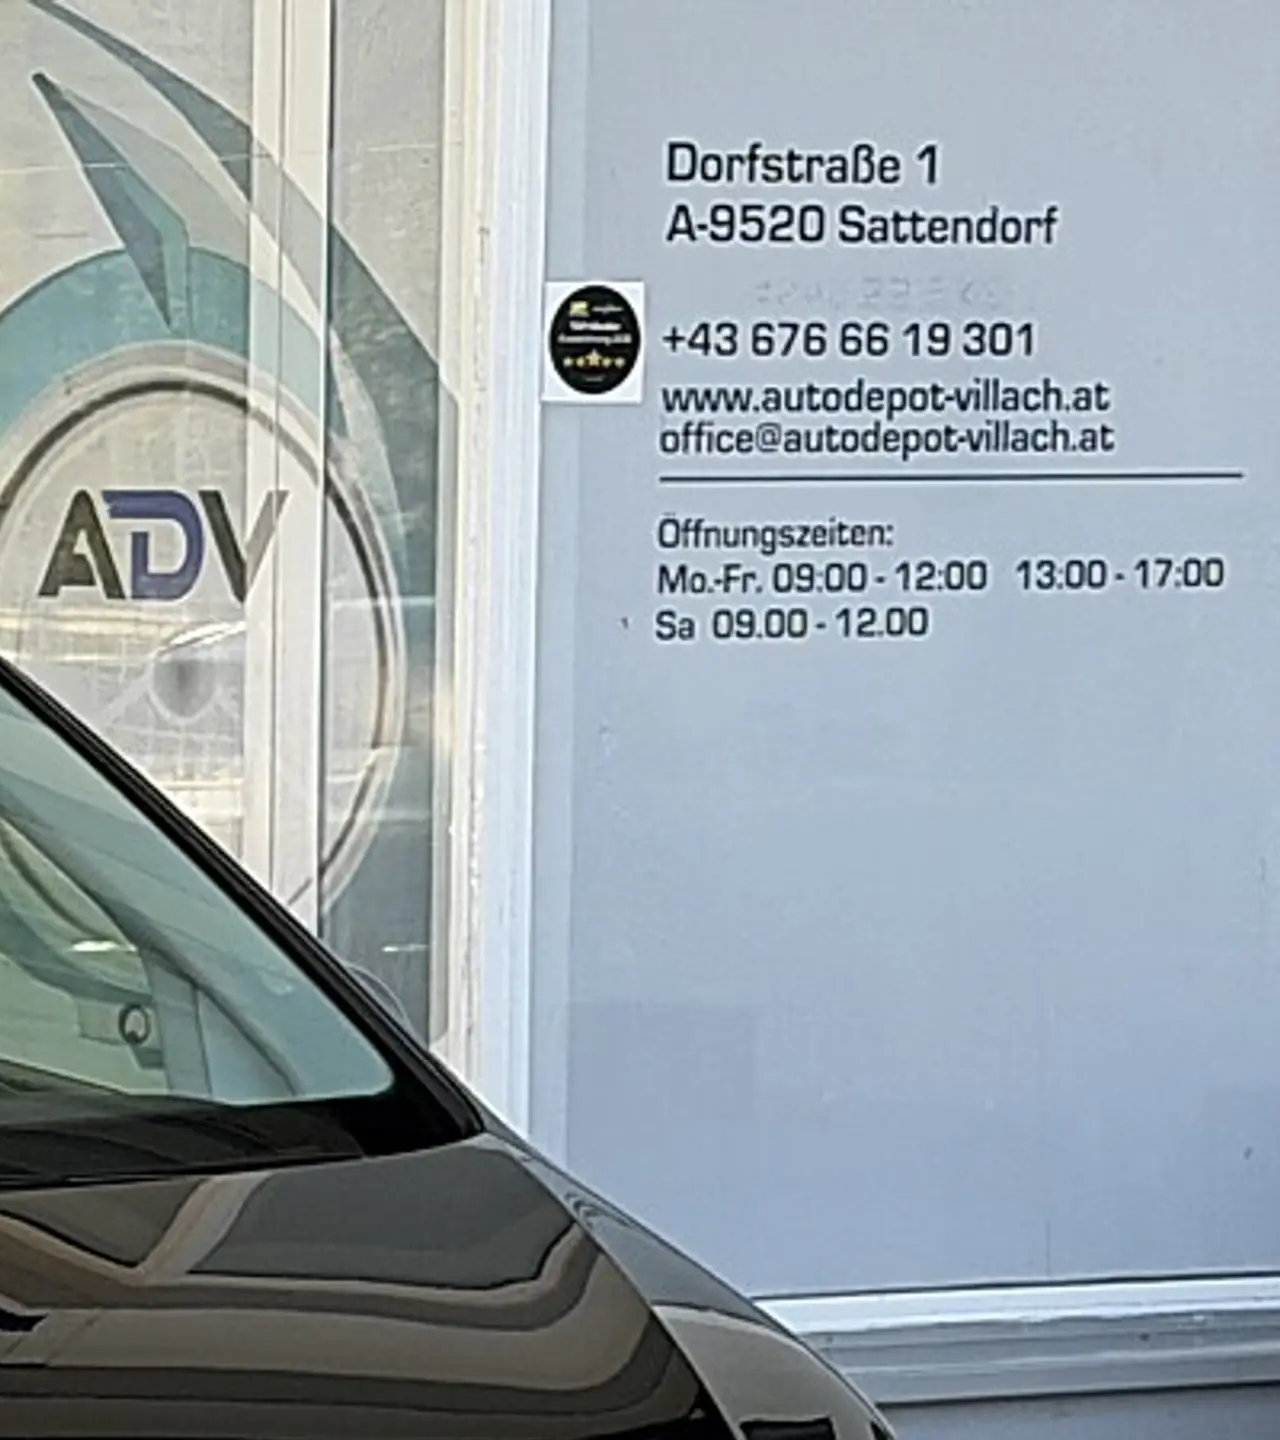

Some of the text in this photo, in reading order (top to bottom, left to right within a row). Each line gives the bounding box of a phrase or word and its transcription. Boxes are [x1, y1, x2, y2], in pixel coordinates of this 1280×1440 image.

[666, 142, 938, 184] Dorfstraße 1
[666, 204, 1059, 244] A-9520 Sattendorf
[663, 322, 739, 356] +43
[751, 322, 828, 357] 676
[840, 322, 890, 357] 66
[903, 322, 951, 356] 19
[963, 322, 1035, 356] 301
[662, 377, 1111, 421] www.autodepot-villach.at
[660, 420, 1115, 462] office@autodepot-villach.at
[38, 488, 290, 603] ADV
[658, 516, 894, 556] Öffnungszeiten:
[658, 563, 763, 595] Mo.-Fr.
[773, 562, 868, 593] 09:00
[895, 561, 988, 591] 12:00
[1016, 560, 1108, 590] 13:00
[1134, 558, 1225, 588] 17:00
[656, 610, 695, 641] Sa
[712, 608, 809, 639] 09.00
[835, 607, 929, 637] 12.00
